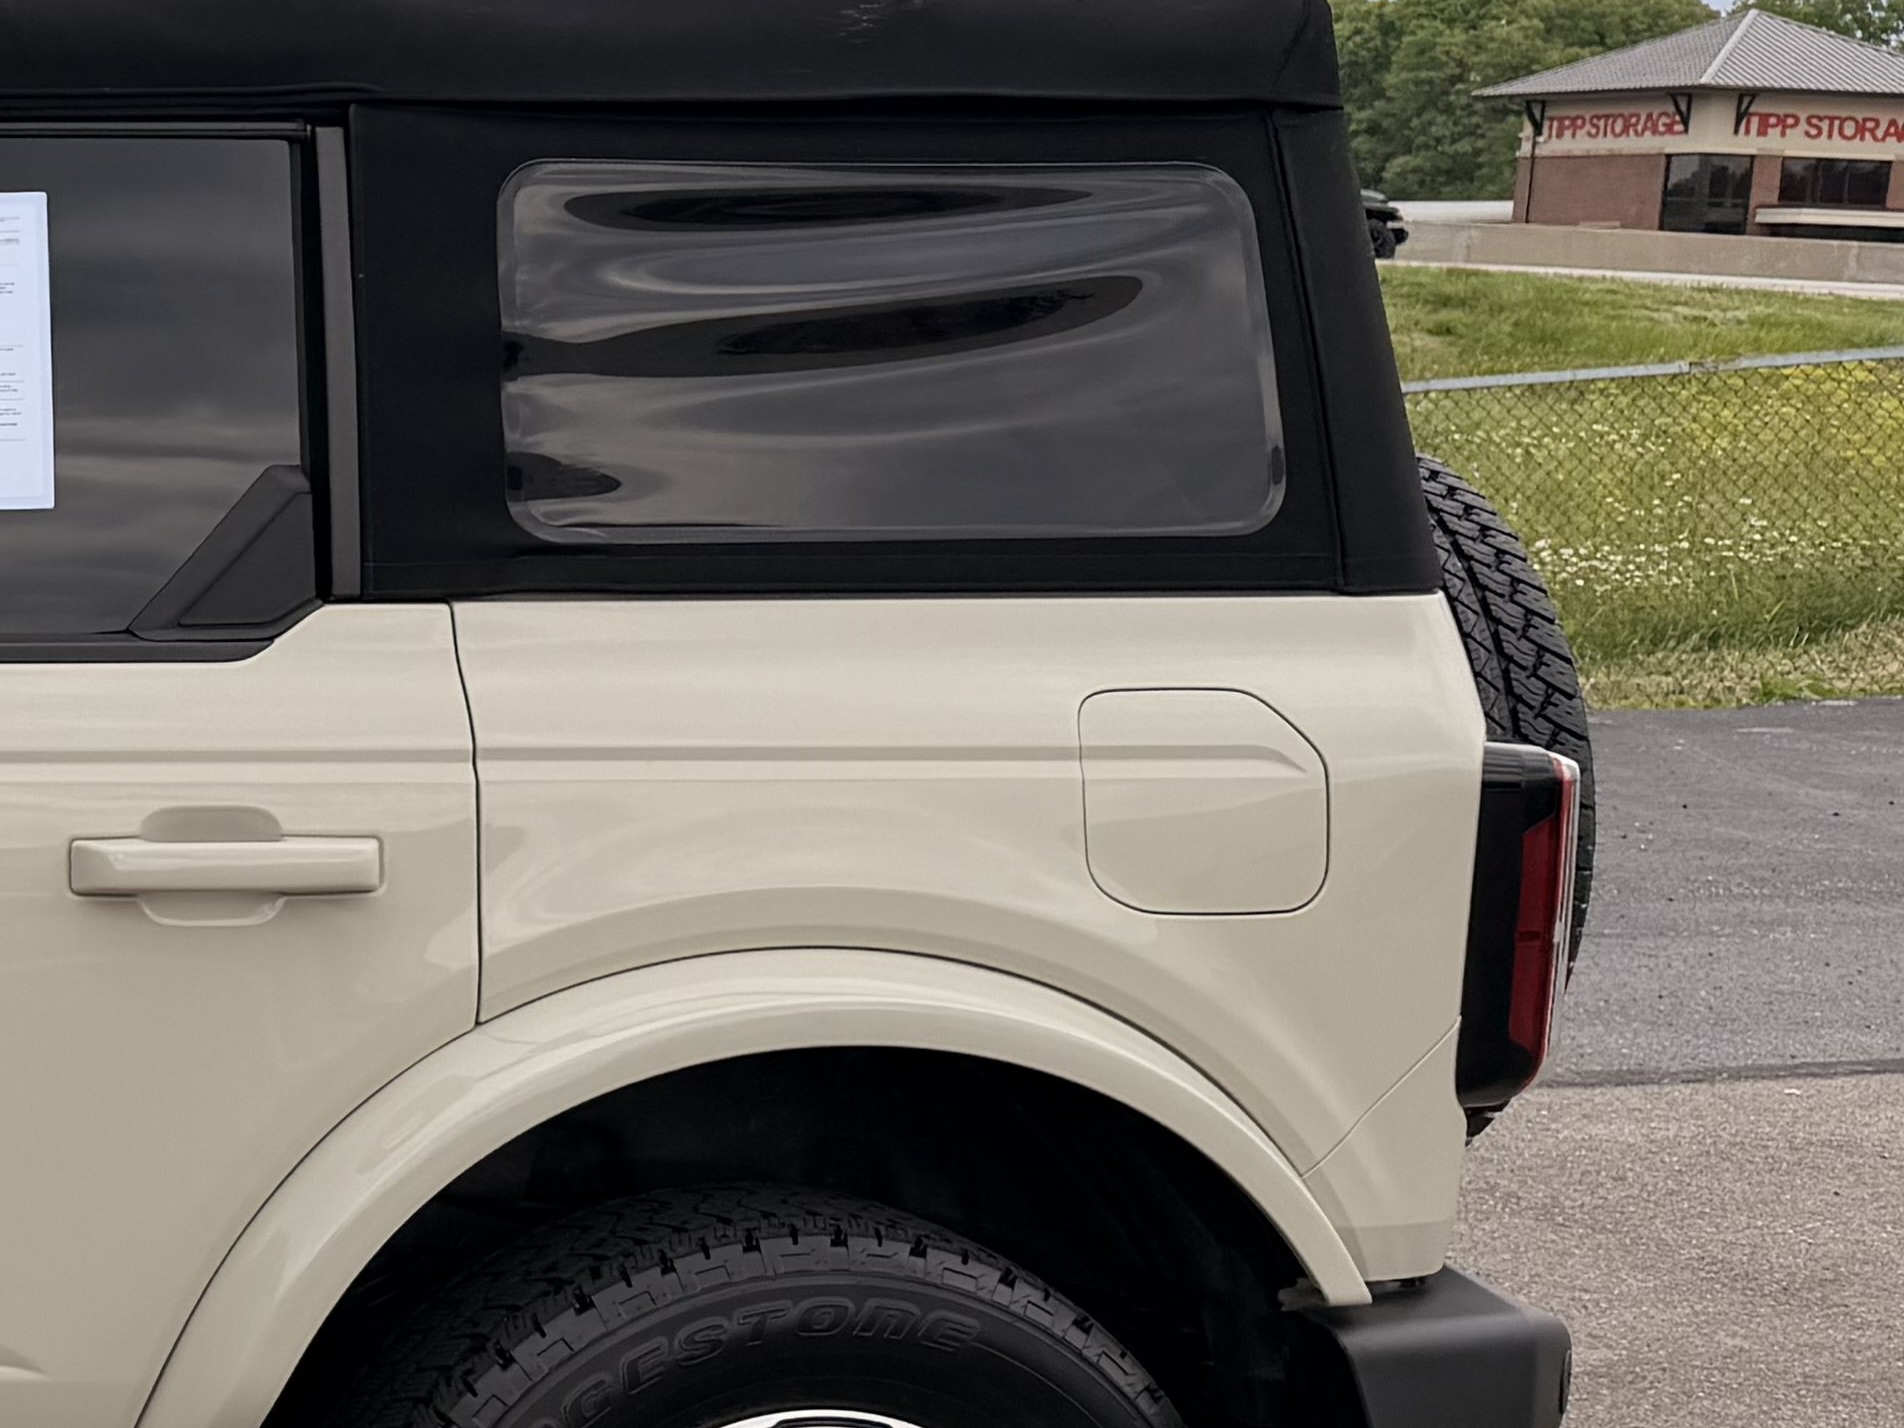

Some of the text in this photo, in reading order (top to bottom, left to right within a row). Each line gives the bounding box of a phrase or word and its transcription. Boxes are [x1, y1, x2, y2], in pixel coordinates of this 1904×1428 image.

[1547, 110, 1687, 141] TIPP STORAGE
[1744, 112, 1904, 143] TIPP STORA
